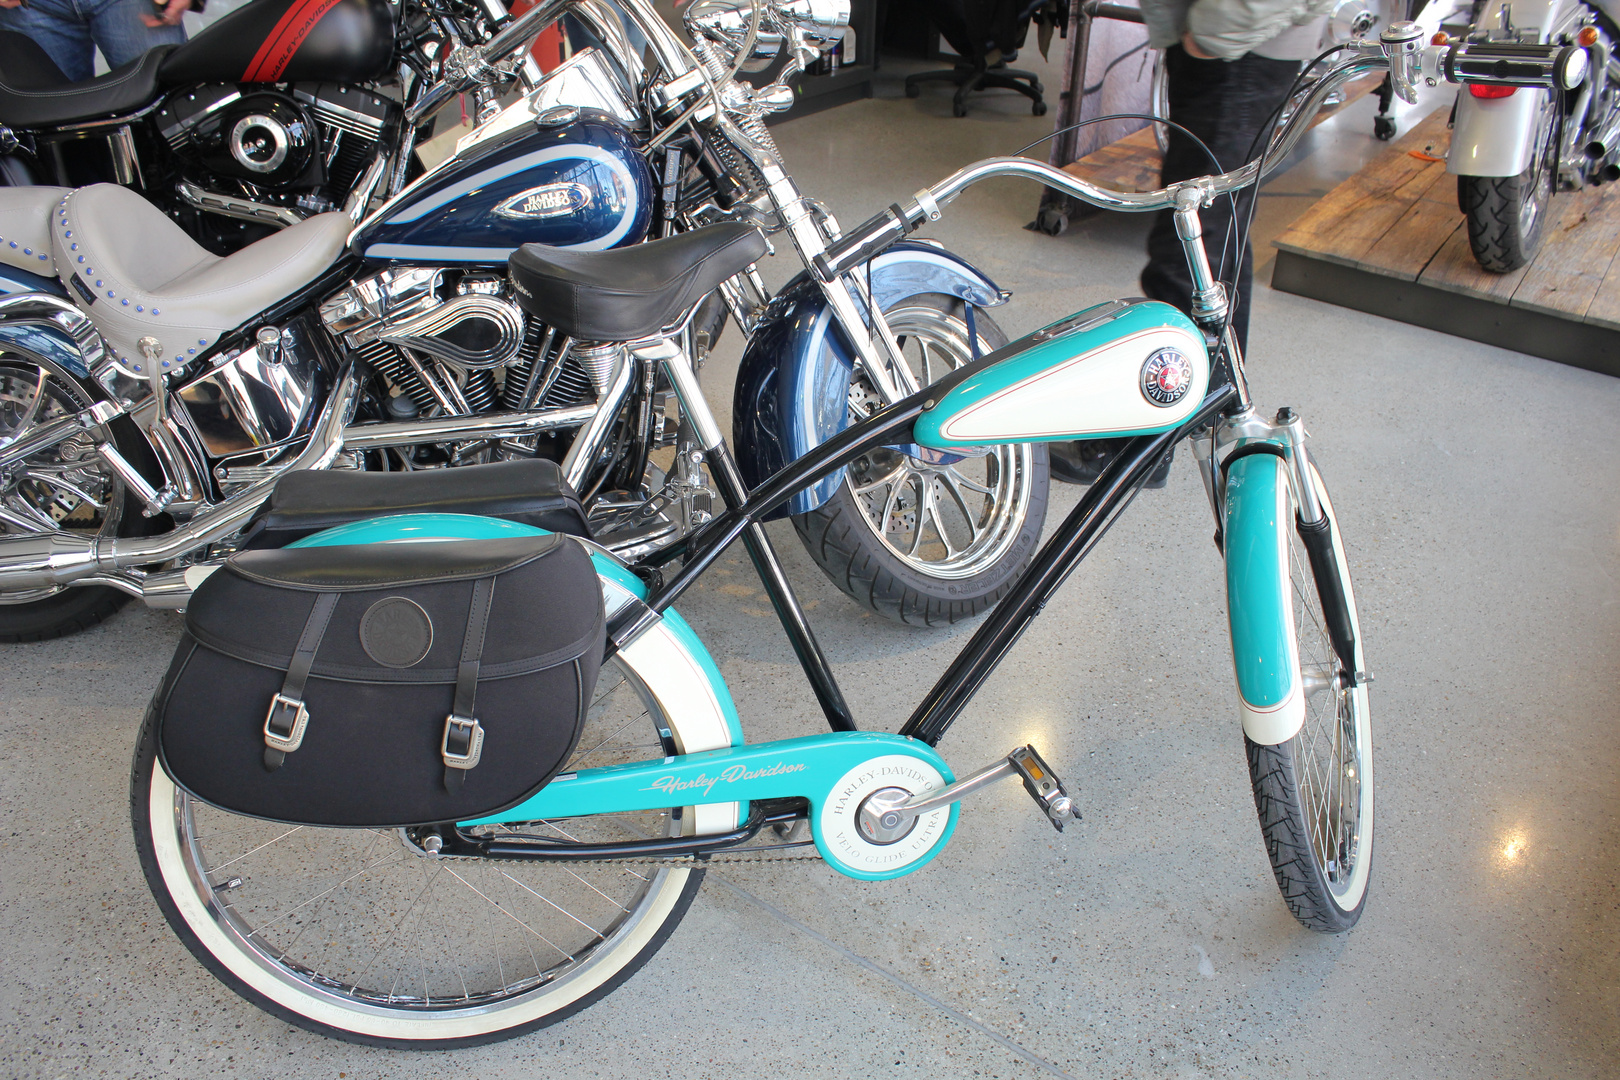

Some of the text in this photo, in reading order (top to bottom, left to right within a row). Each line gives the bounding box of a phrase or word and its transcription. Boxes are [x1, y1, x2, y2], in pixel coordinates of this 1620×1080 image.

[270, 0, 334, 79] HARLEY-DAVIDS
[523, 195, 579, 213] DAVIDSON
[527, 189, 569, 203] HARLEY
[1148, 353, 1191, 375] HARLEY
[1147, 376, 1190, 402] DAVIDSON
[834, 766, 935, 815] HARLEY-DAVIDSO
[836, 811, 940, 864] VELO GLIDE ULTRA
